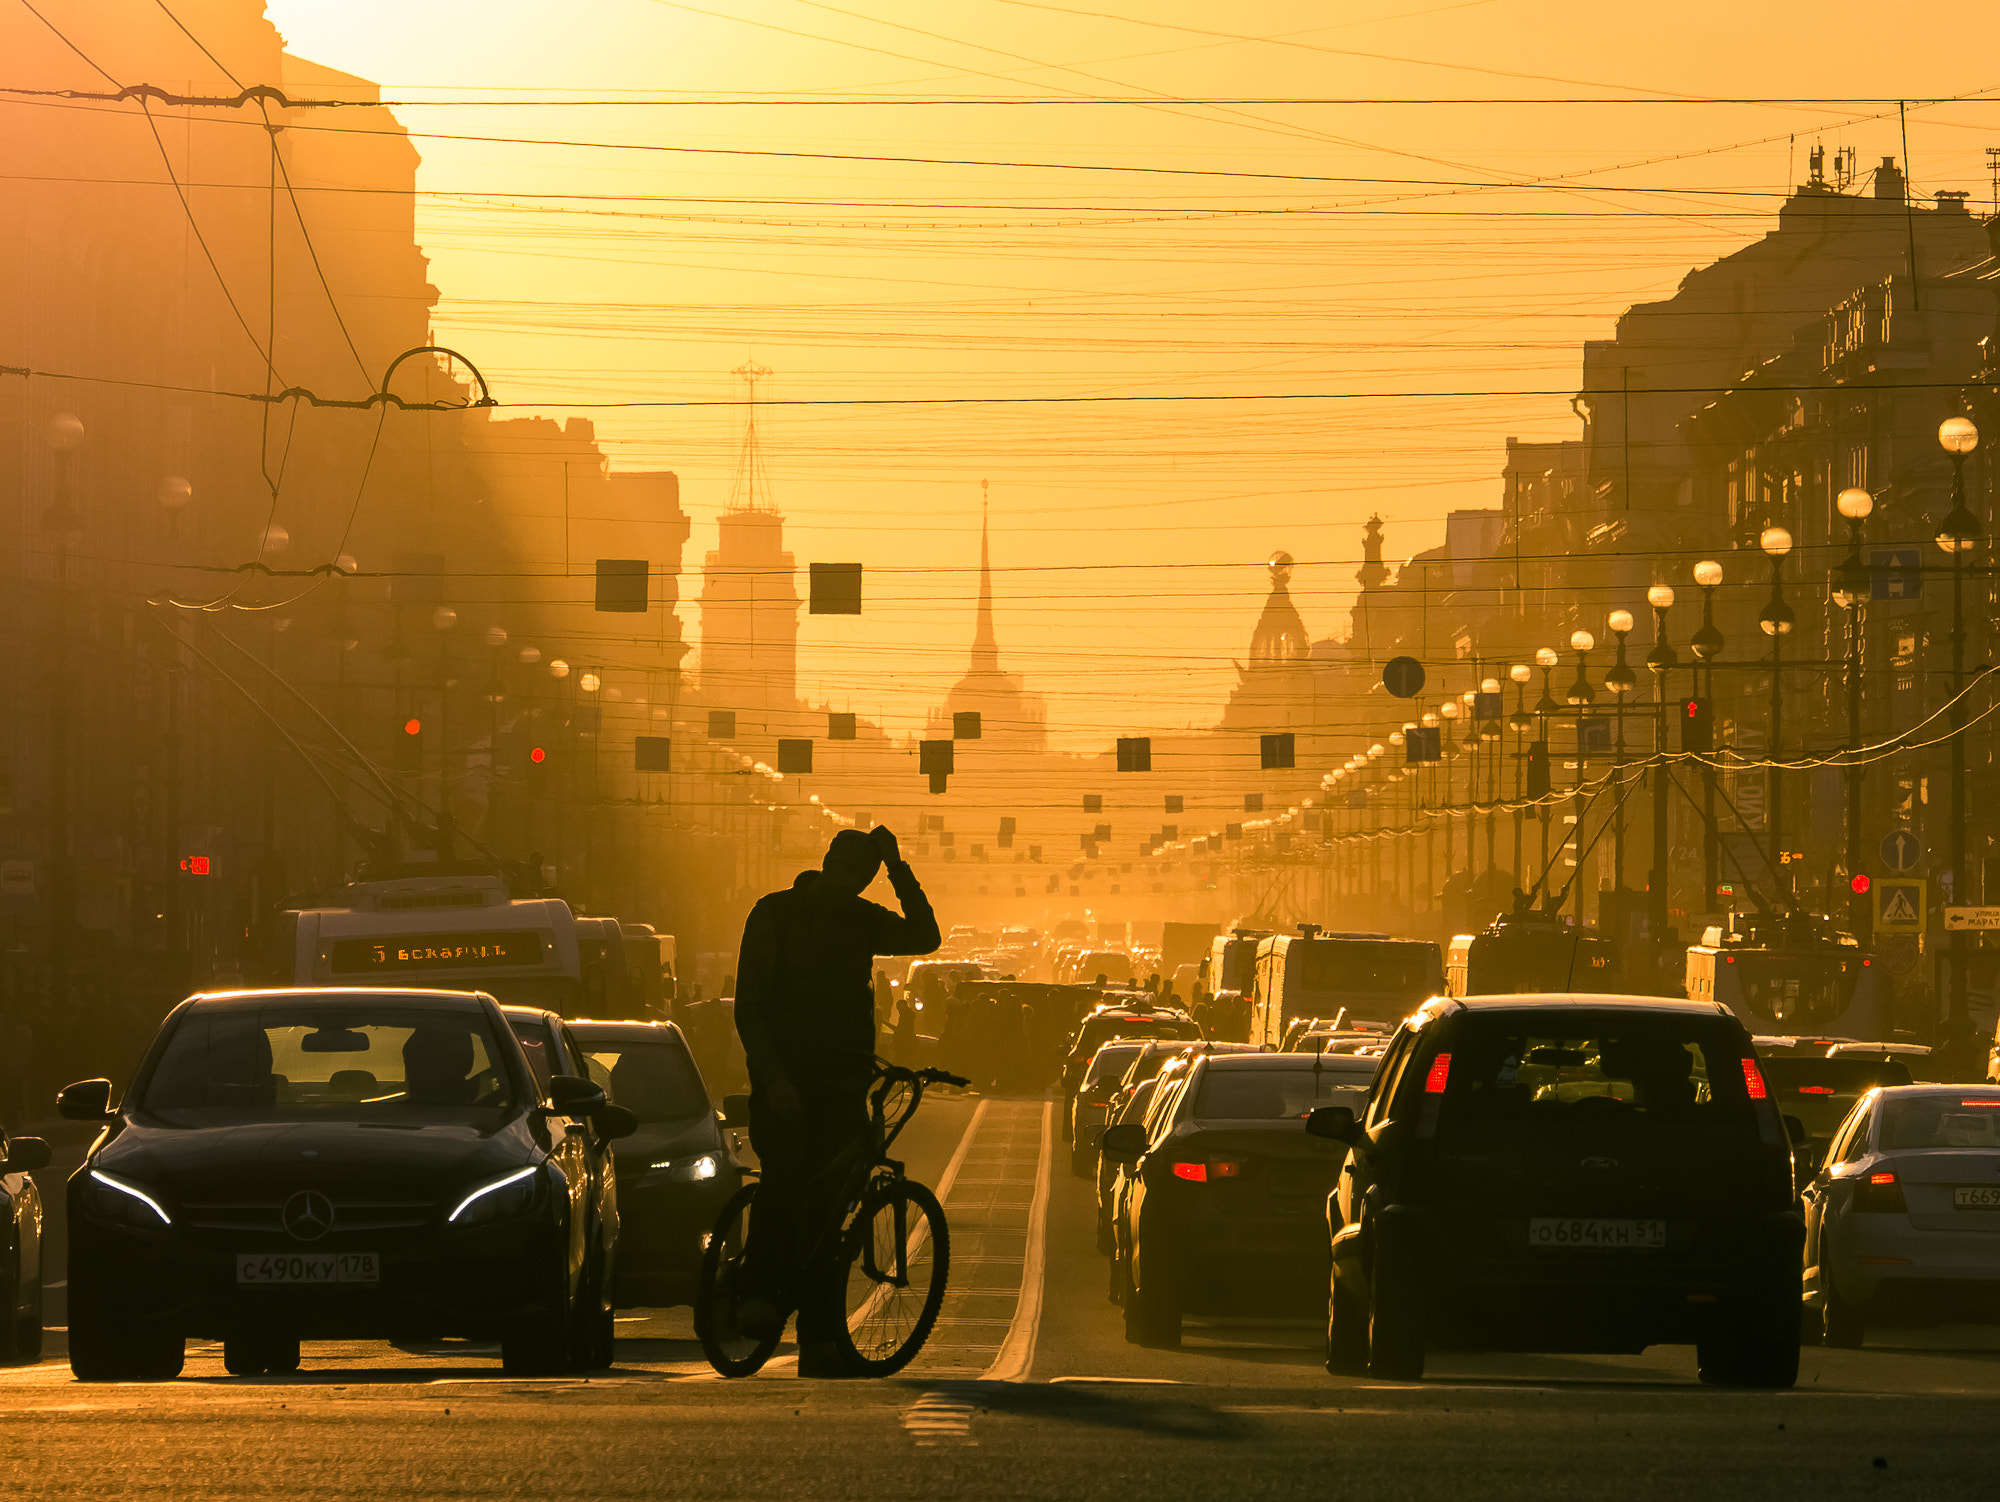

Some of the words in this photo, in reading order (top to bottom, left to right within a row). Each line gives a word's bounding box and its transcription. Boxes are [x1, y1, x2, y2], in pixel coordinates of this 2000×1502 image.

[1967, 918, 2000, 926] МАРАТ
[1635, 1221, 1657, 1238] 51
[243, 1257, 334, 1280] С490КУ
[339, 1255, 373, 1273] 178
